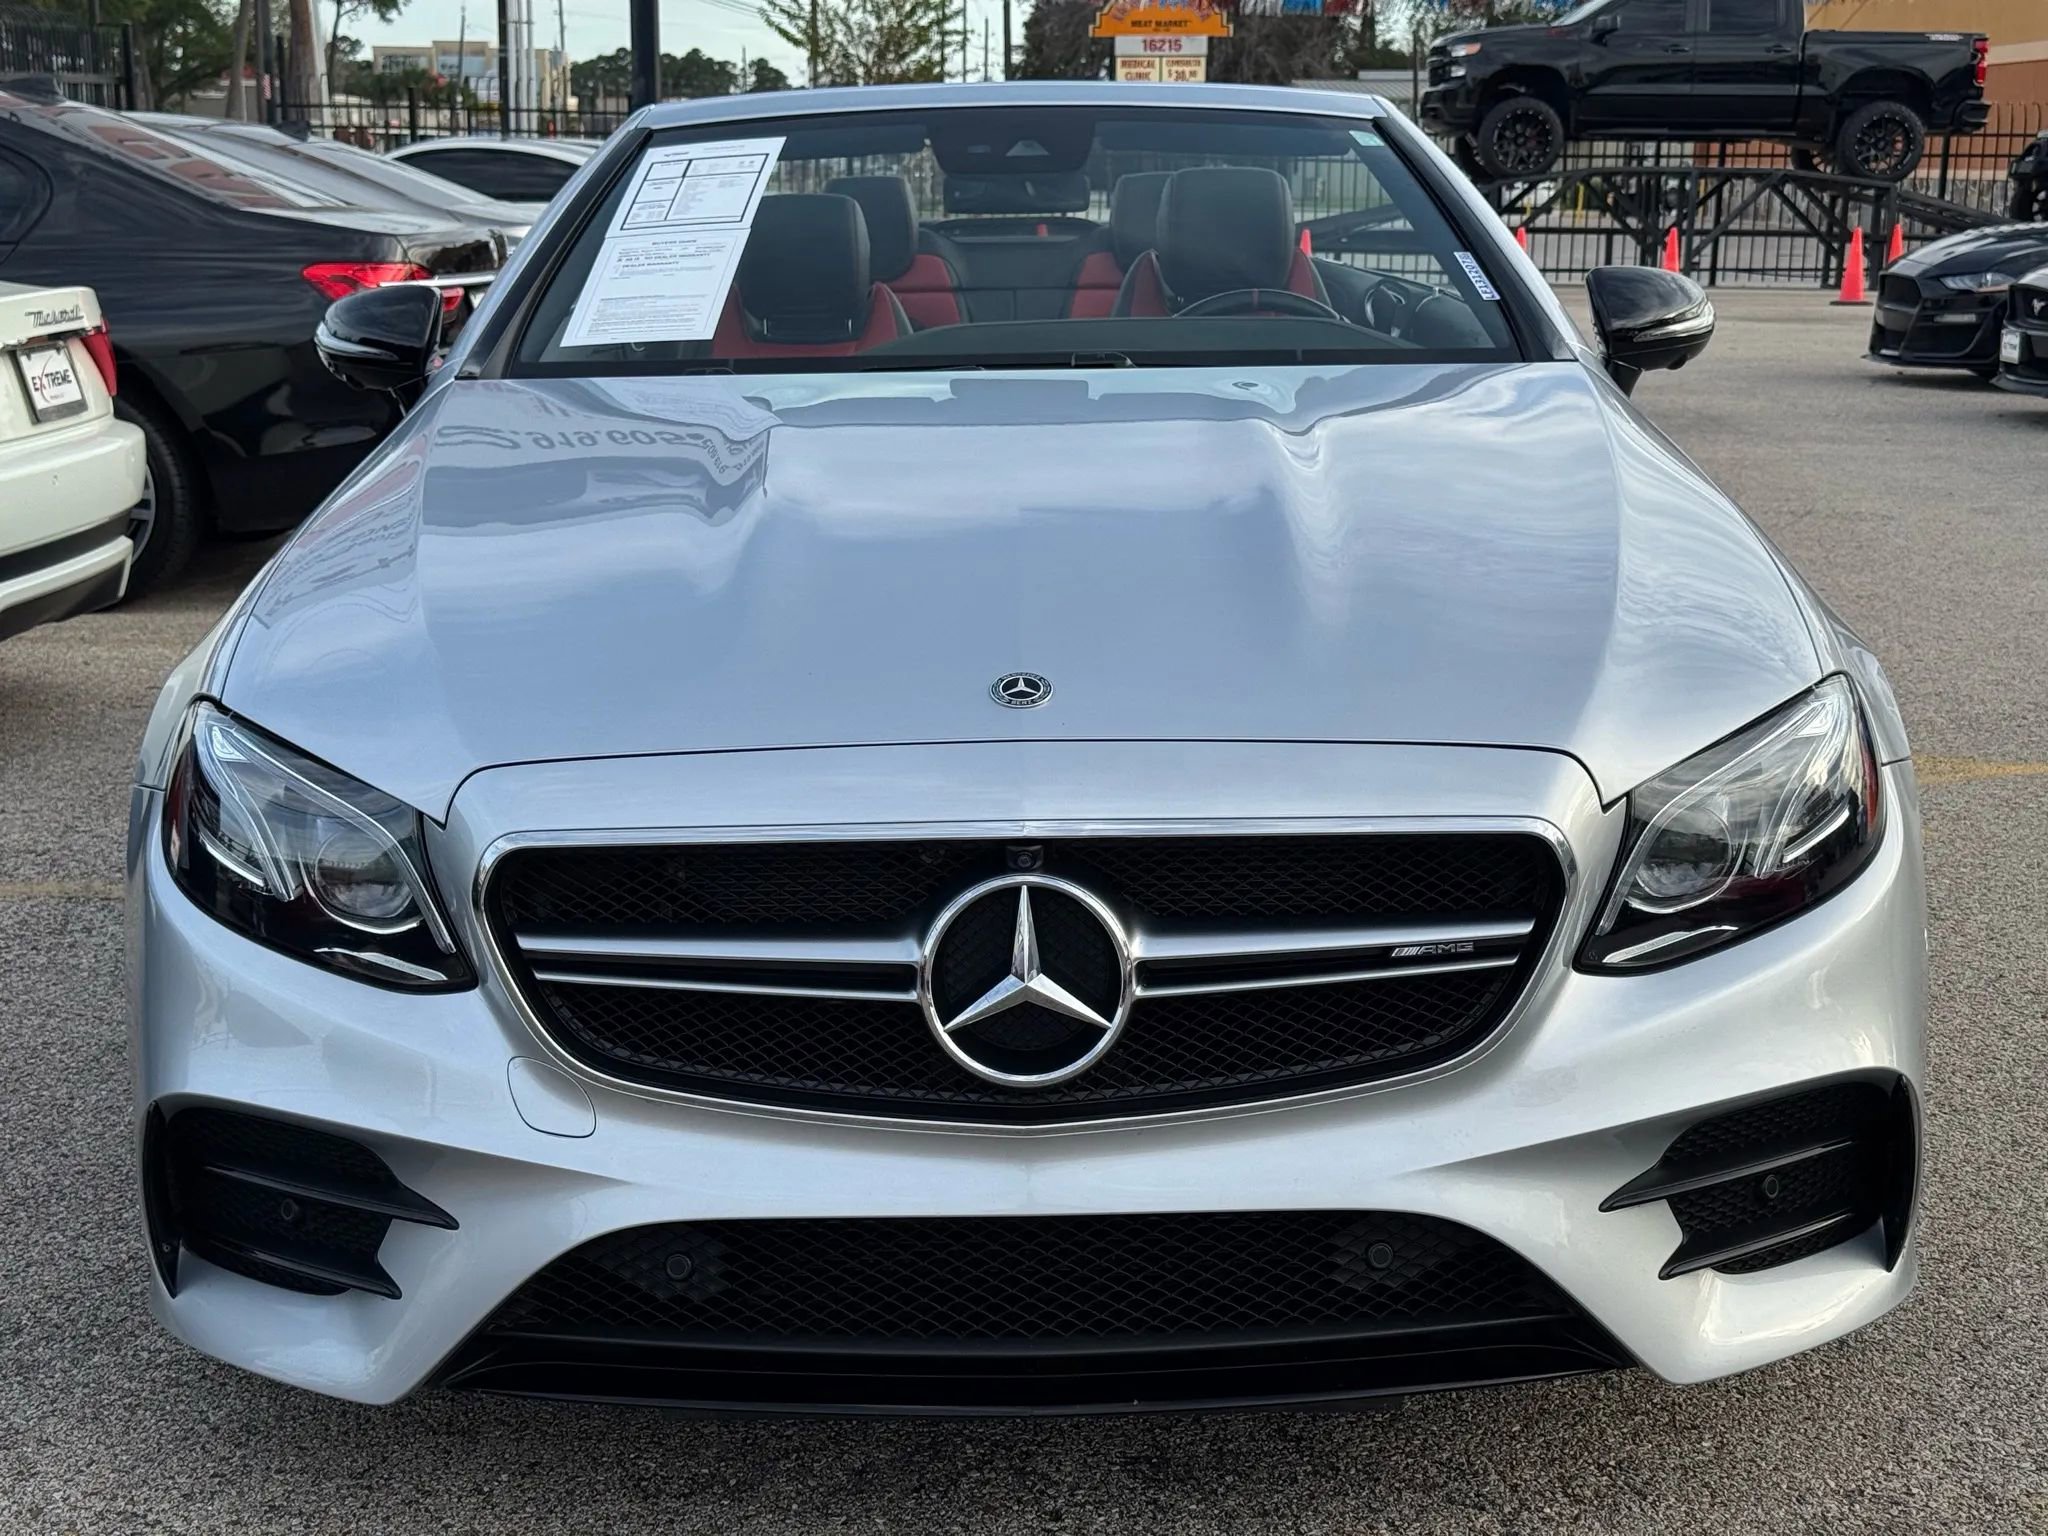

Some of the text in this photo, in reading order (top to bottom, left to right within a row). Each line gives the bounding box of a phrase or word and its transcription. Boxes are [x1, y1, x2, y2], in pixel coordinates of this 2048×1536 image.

[1155, 20, 1188, 28] MARKET
[1142, 39, 1183, 52] 16215
[31, 369, 72, 392] EXTREME
